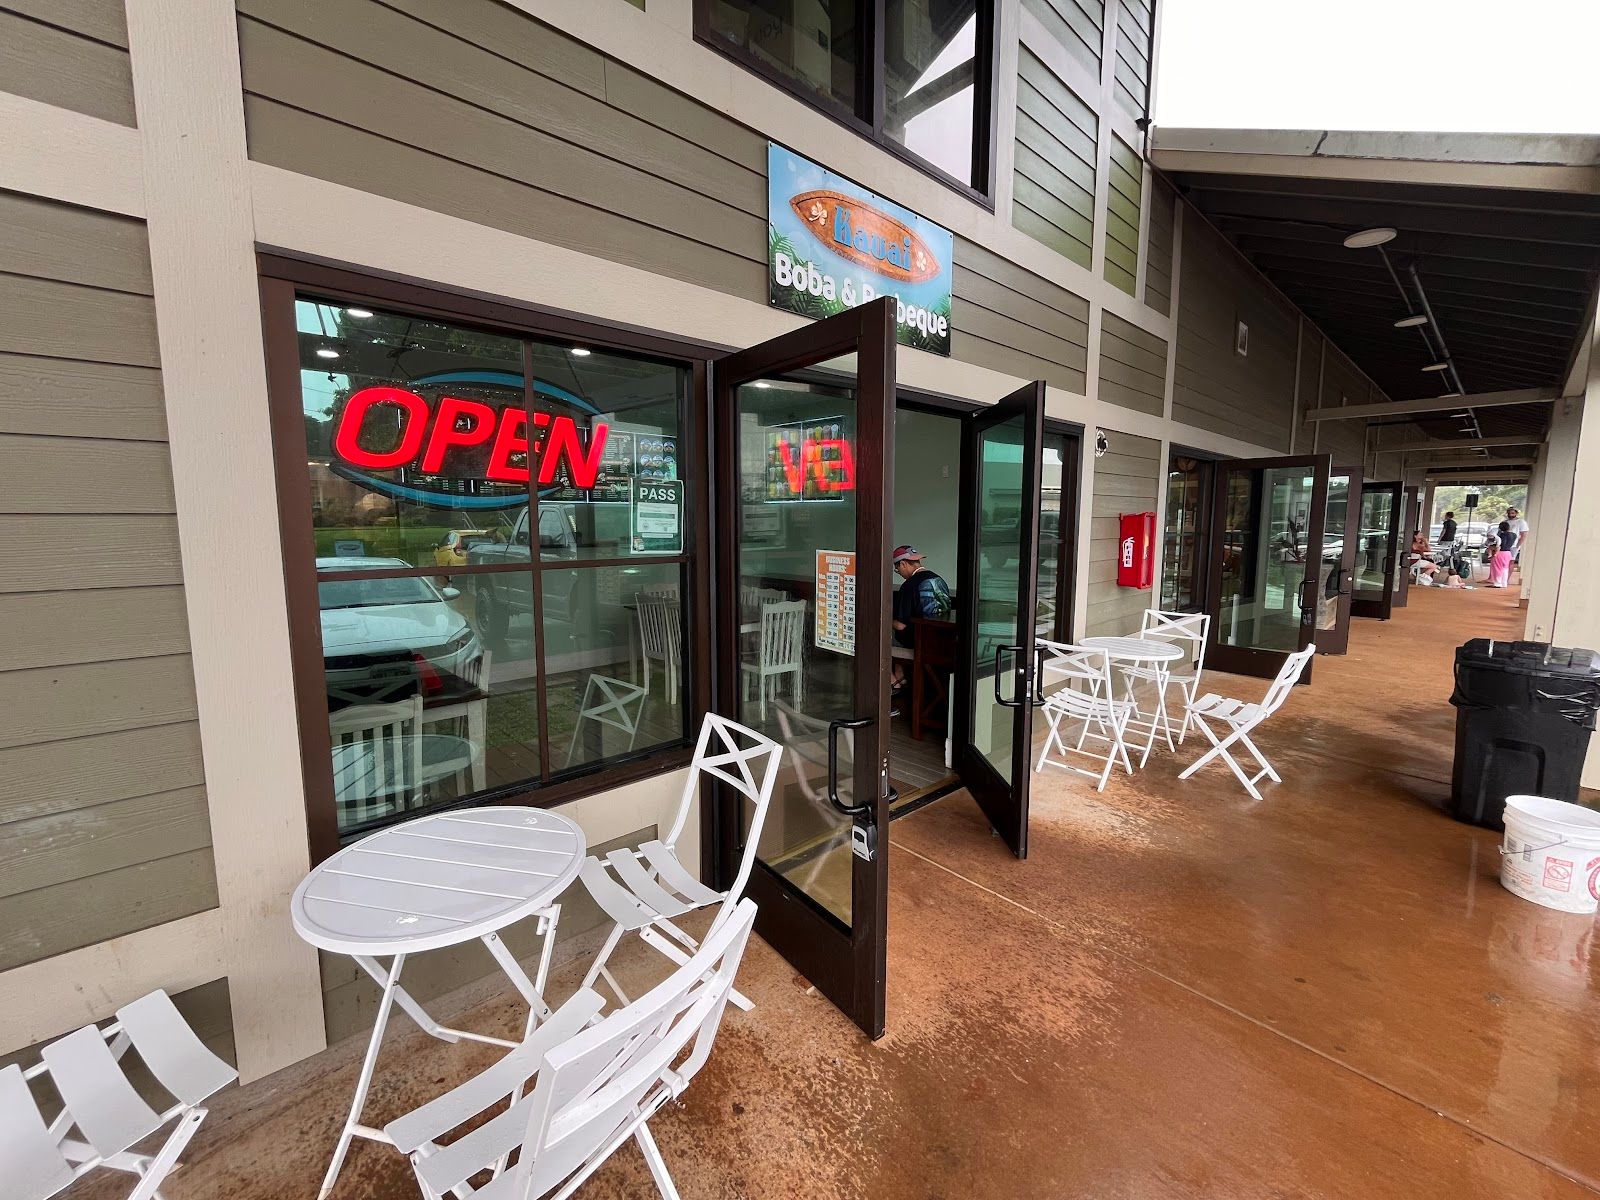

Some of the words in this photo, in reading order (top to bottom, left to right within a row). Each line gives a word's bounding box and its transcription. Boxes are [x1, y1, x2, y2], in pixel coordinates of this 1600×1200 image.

[833, 205, 912, 271] Kauai
[775, 252, 836, 301] Boba
[841, 277, 857, 308] &
[862, 283, 948, 337] Bbeque
[335, 386, 609, 490] OPEN
[639, 487, 676, 502] PASS
